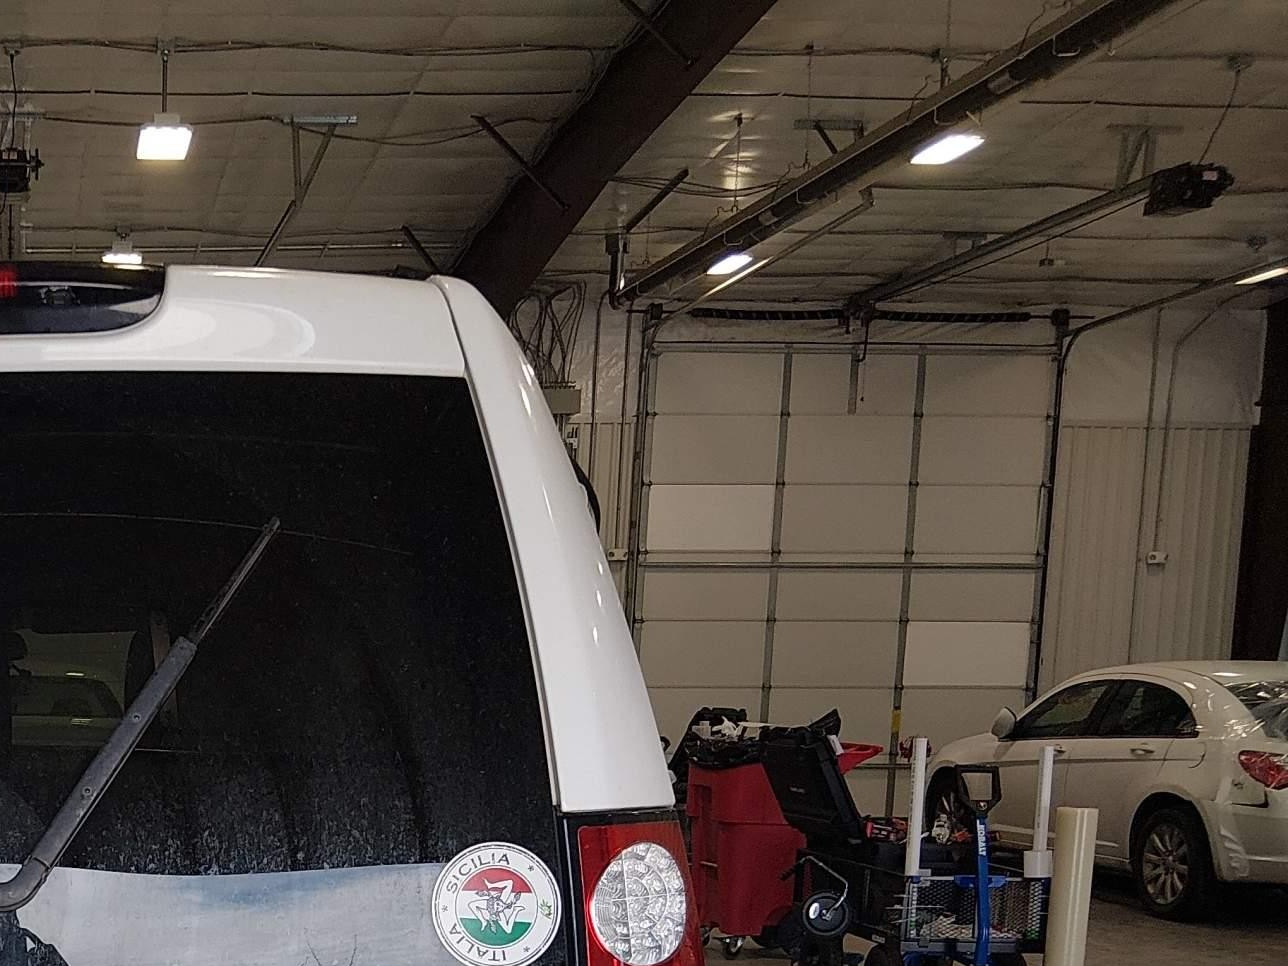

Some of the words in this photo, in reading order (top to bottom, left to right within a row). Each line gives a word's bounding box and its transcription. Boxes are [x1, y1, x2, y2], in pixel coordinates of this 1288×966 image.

[976, 819, 987, 856] KOBALT
[446, 853, 510, 894] SICILIA
[449, 923, 506, 961] ITALIA
